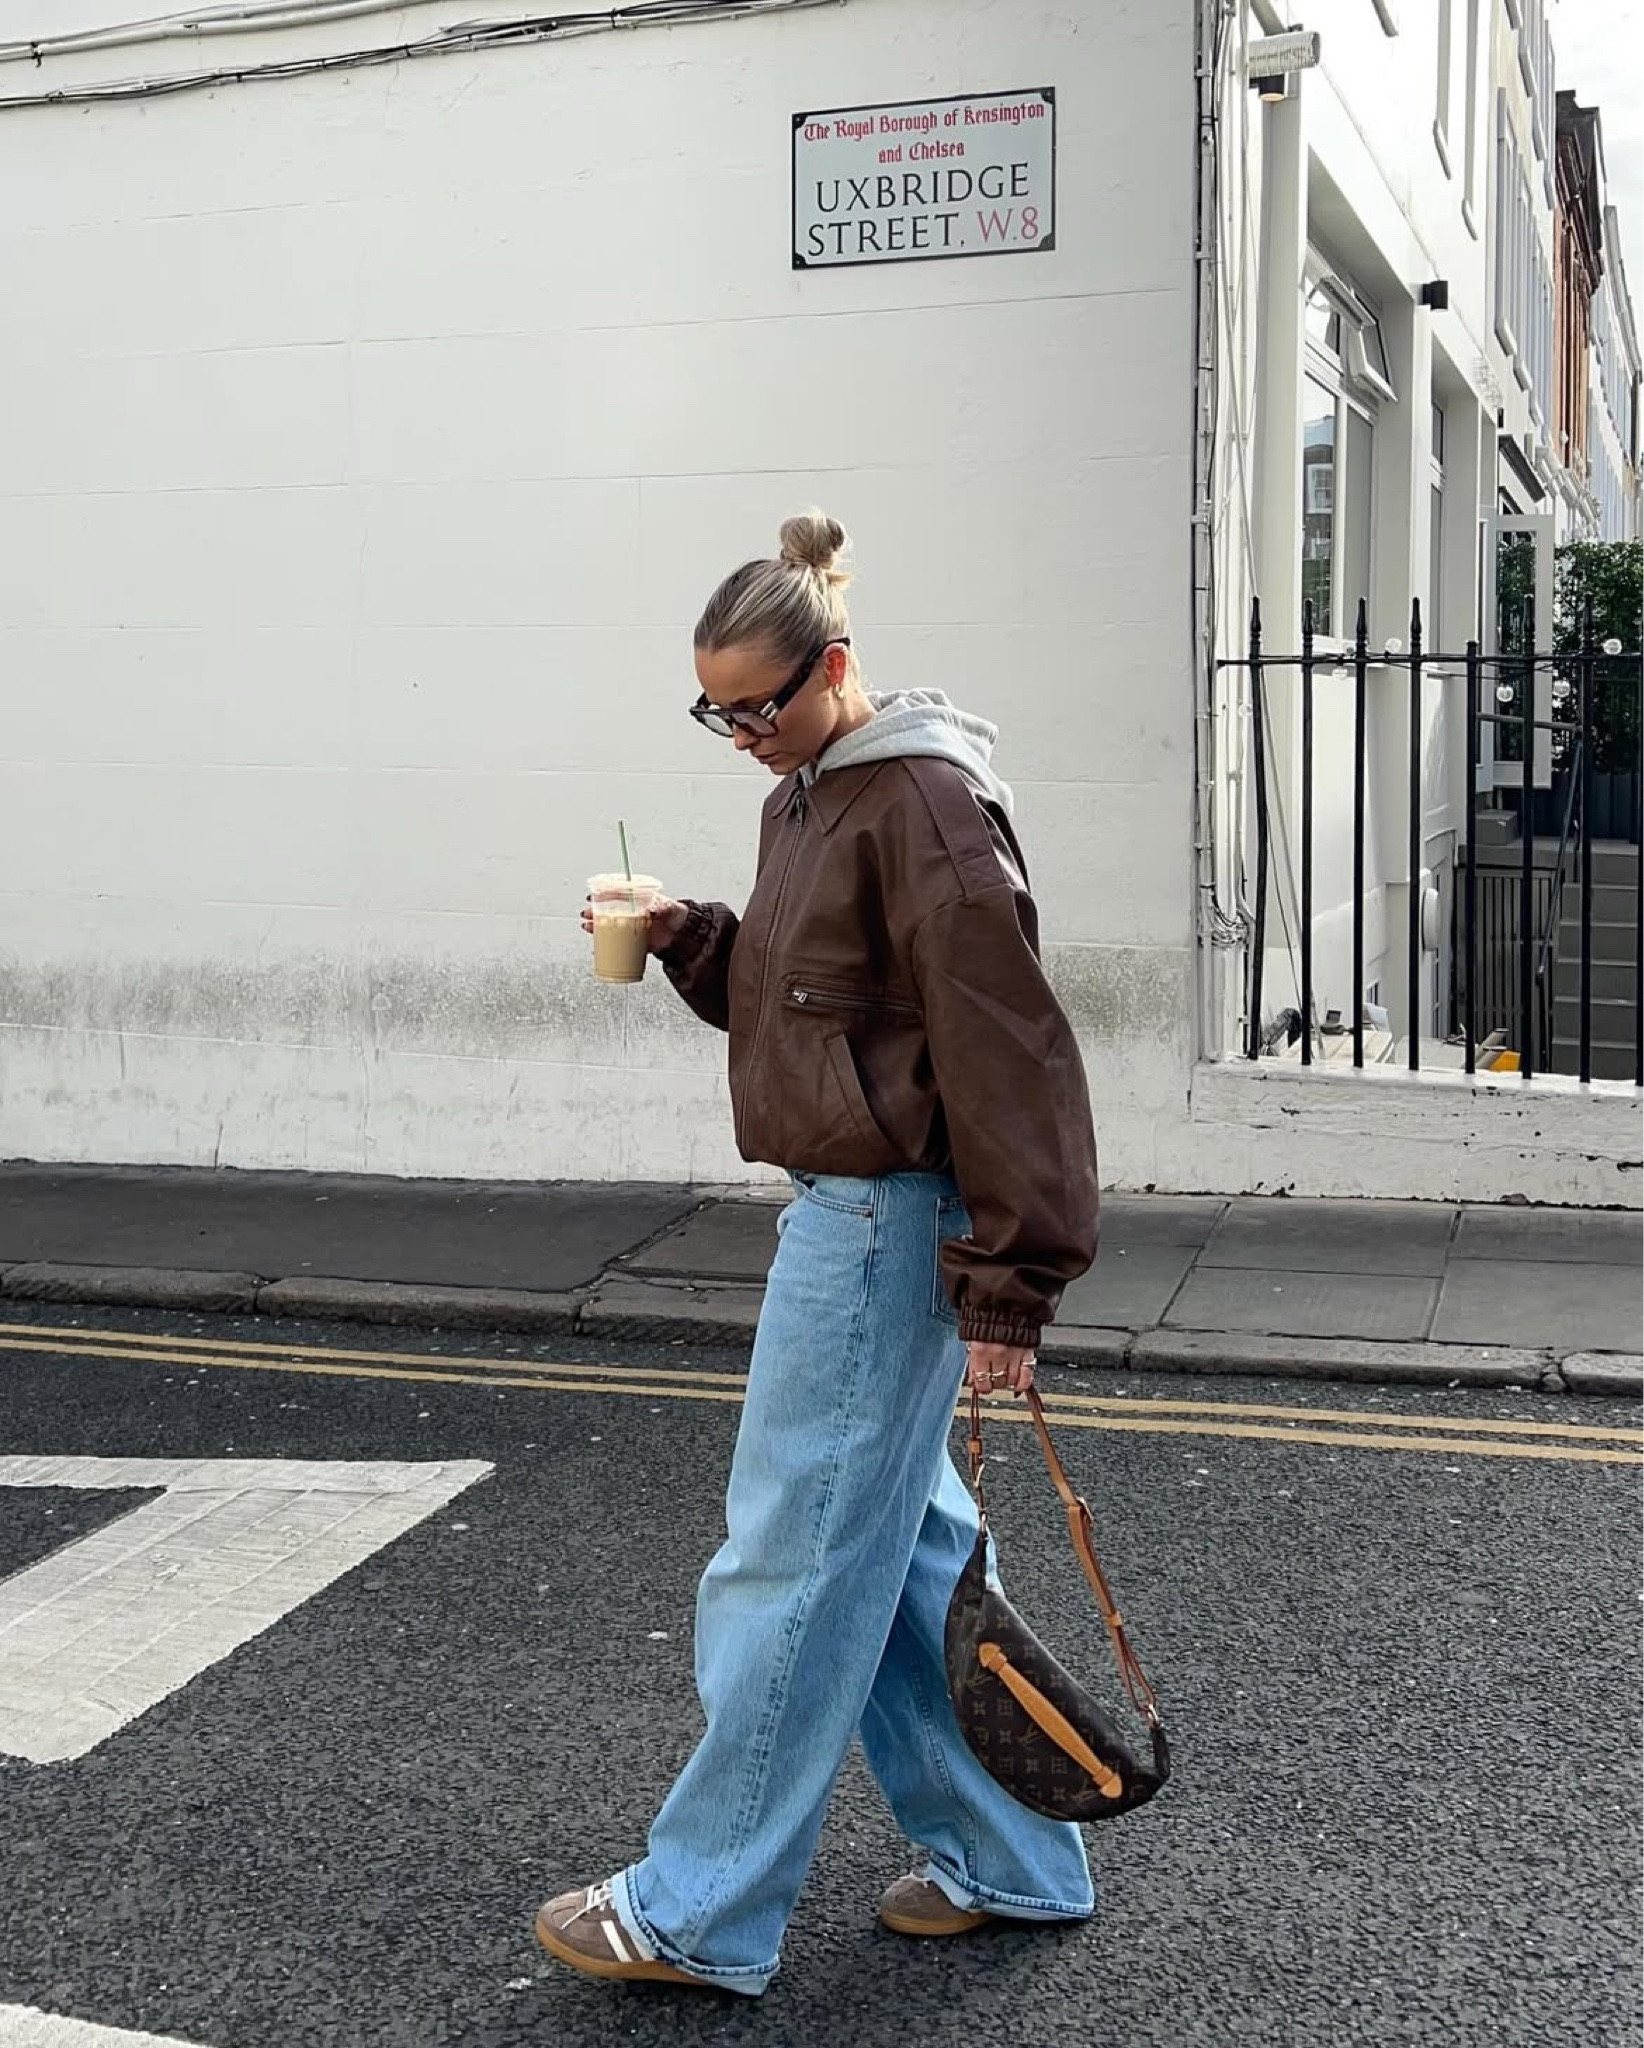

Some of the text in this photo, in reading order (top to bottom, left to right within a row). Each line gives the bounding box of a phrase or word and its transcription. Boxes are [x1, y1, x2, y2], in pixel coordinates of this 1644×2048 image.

[804, 103, 1045, 142] The Royal Borough of Kensington
[878, 140, 965, 164] and Chelsea
[816, 162, 1030, 213] UXBRIDGE
[975, 206, 1039, 243] W.8
